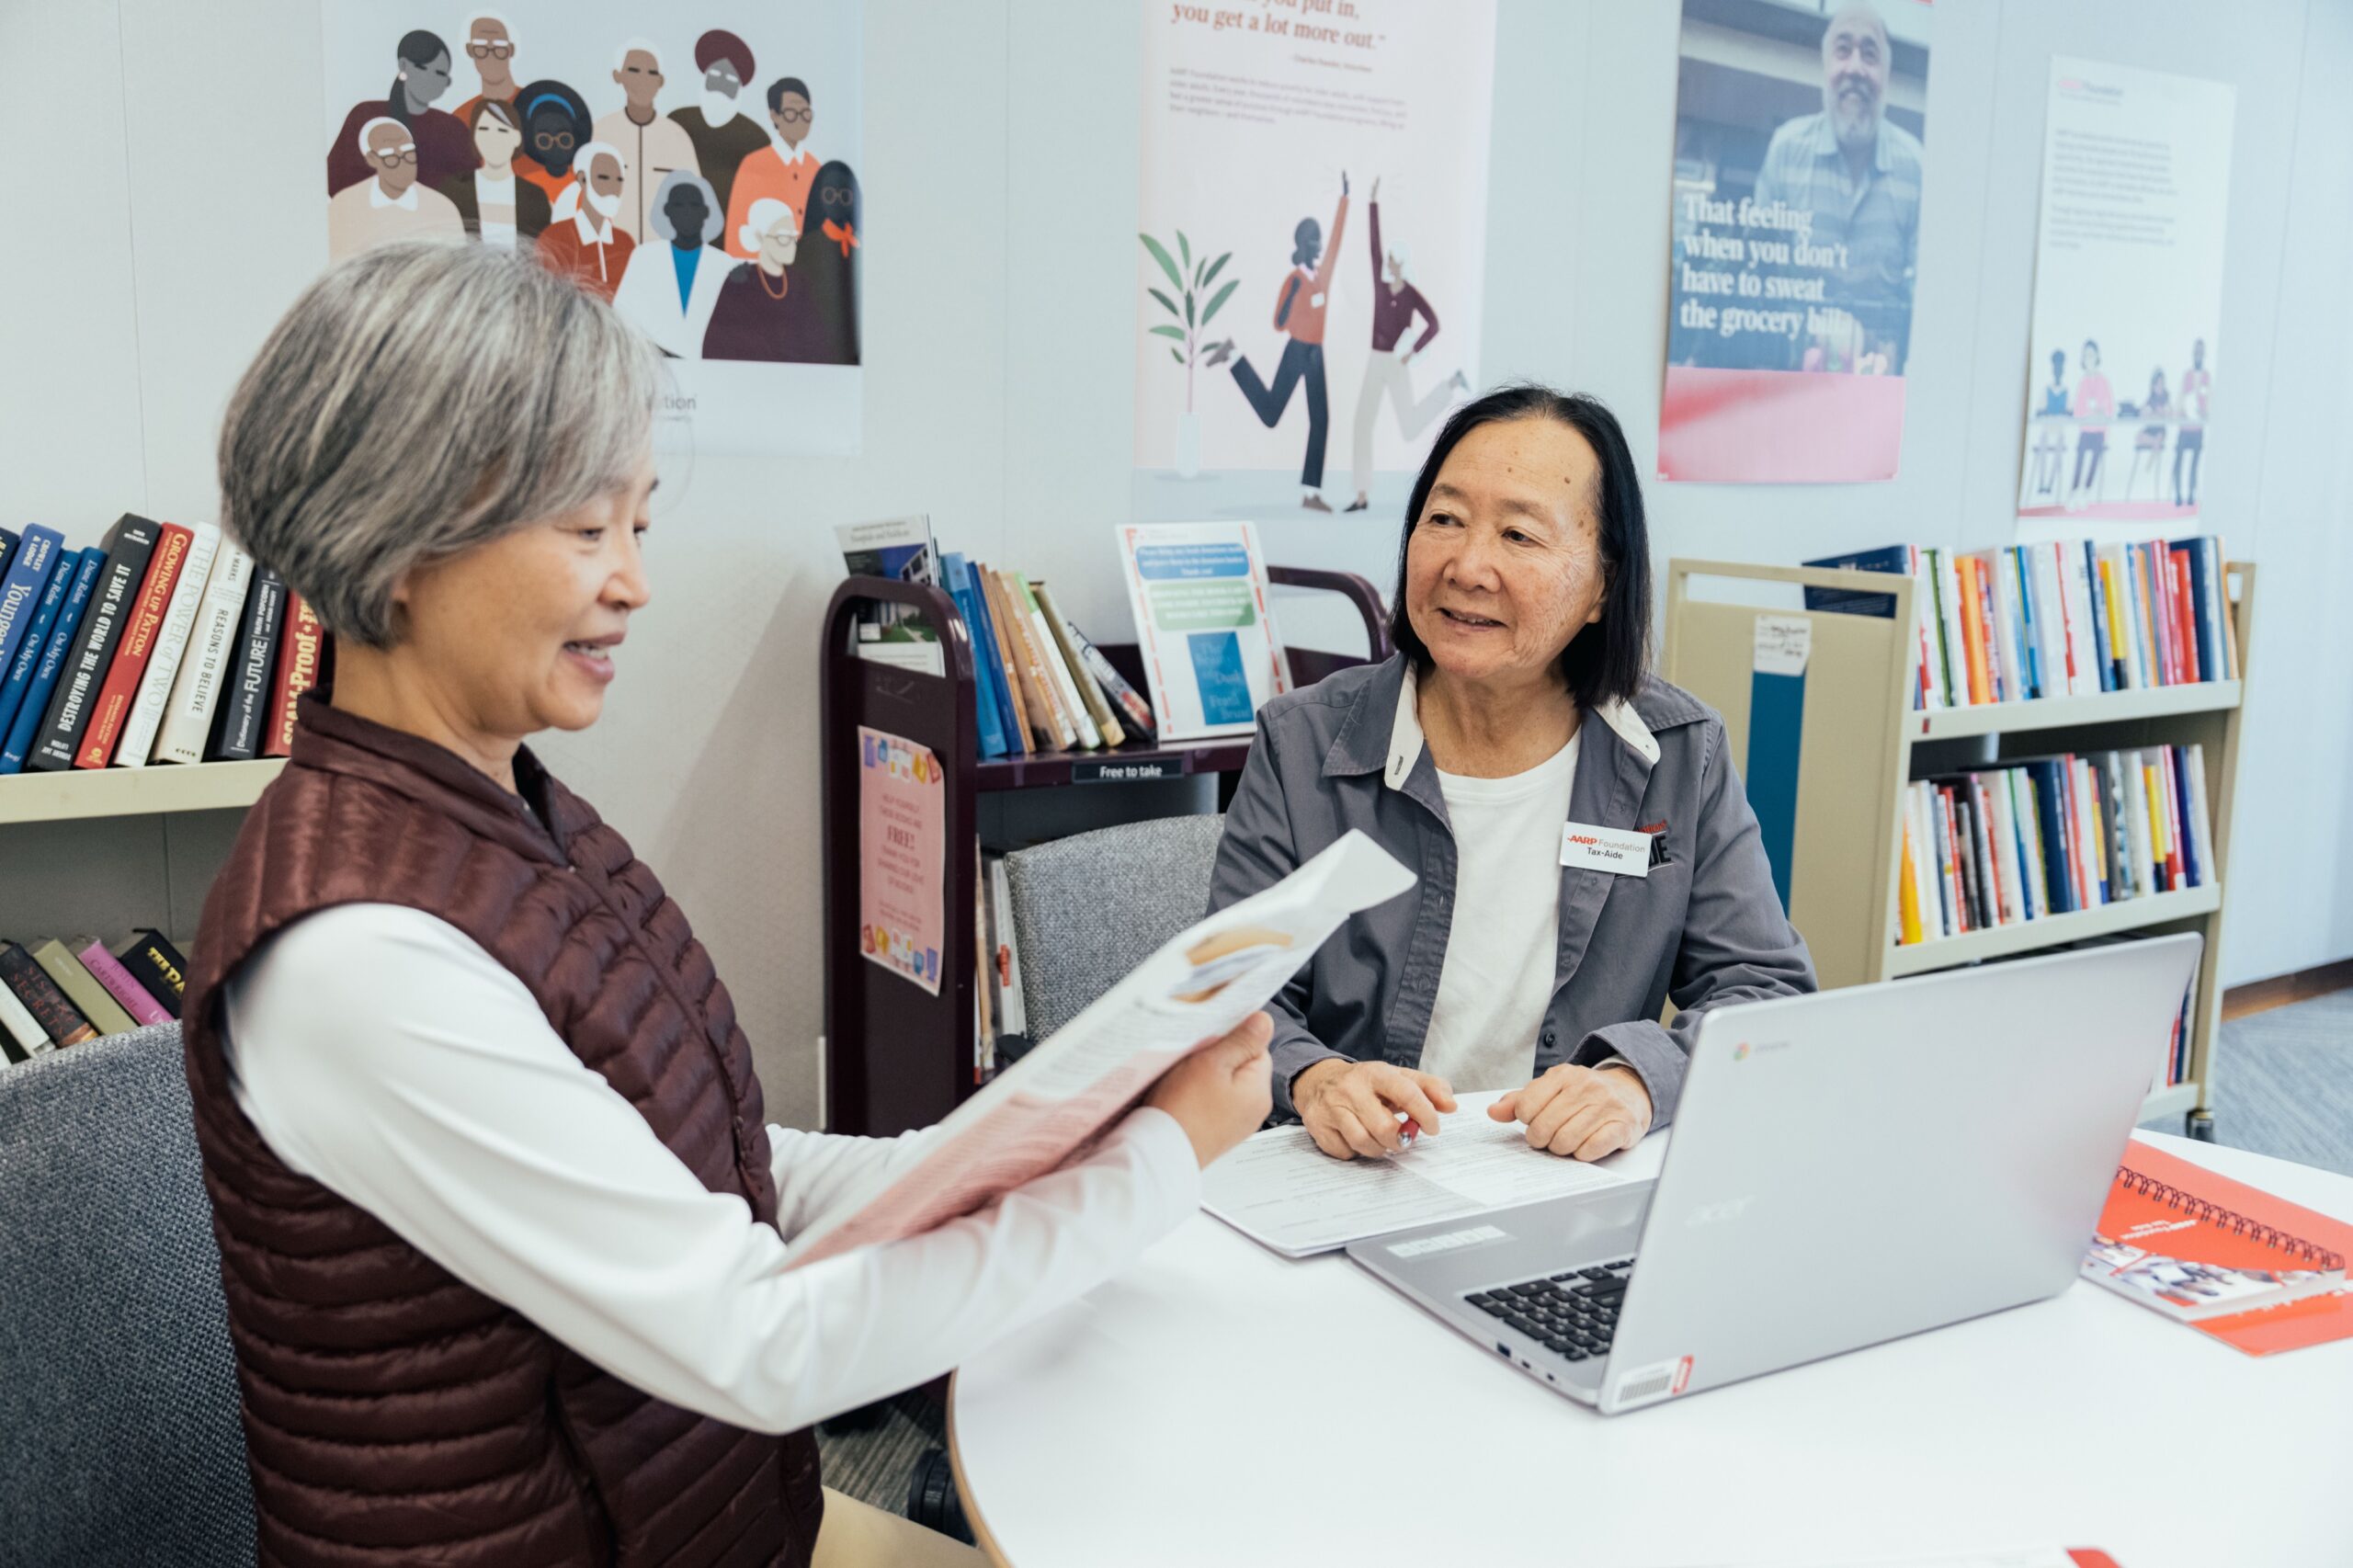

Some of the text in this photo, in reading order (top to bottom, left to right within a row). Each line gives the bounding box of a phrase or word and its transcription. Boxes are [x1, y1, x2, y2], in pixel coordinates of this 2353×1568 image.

[1171, 2, 1209, 24] you
[1213, 10, 1243, 30] get
[1249, 17, 1258, 30] a
[1265, 13, 1289, 35] lot
[1293, 24, 1340, 44] more
[1682, 193, 1813, 236] That feeling
[1684, 228, 1847, 269] when you don't
[1681, 263, 1824, 301] have to sweat
[1680, 297, 1717, 329] the
[1721, 304, 1803, 339] grocery
[23, 542, 38, 567] LODGE
[32, 540, 51, 572] CROWLEY
[82, 560, 97, 585] Diane
[46, 562, 71, 605] Diane Rehm
[132, 533, 187, 656] GROWING UP PATTON
[148, 541, 213, 706] THE POWER of TWO
[254, 585, 269, 634] FAITH POPCORN
[13, 633, 40, 681] On My Own
[41, 632, 67, 679] On My Own
[57, 563, 131, 732] DESTROYING THE WORLD TO SAVE IT
[191, 608, 228, 713] REASONS TO BELIEVE
[236, 640, 267, 747] Dictionary of the FUTURE
[1099, 764, 1163, 778] Free to take
[887, 824, 915, 849] FREE!
[1568, 835, 1645, 852] AARP Foundation
[1588, 847, 1623, 858] Tax-Aide
[148, 947, 170, 971] THE
[8, 974, 67, 1035] SECRETS
[89, 957, 137, 1010] CARTWRIGHT
